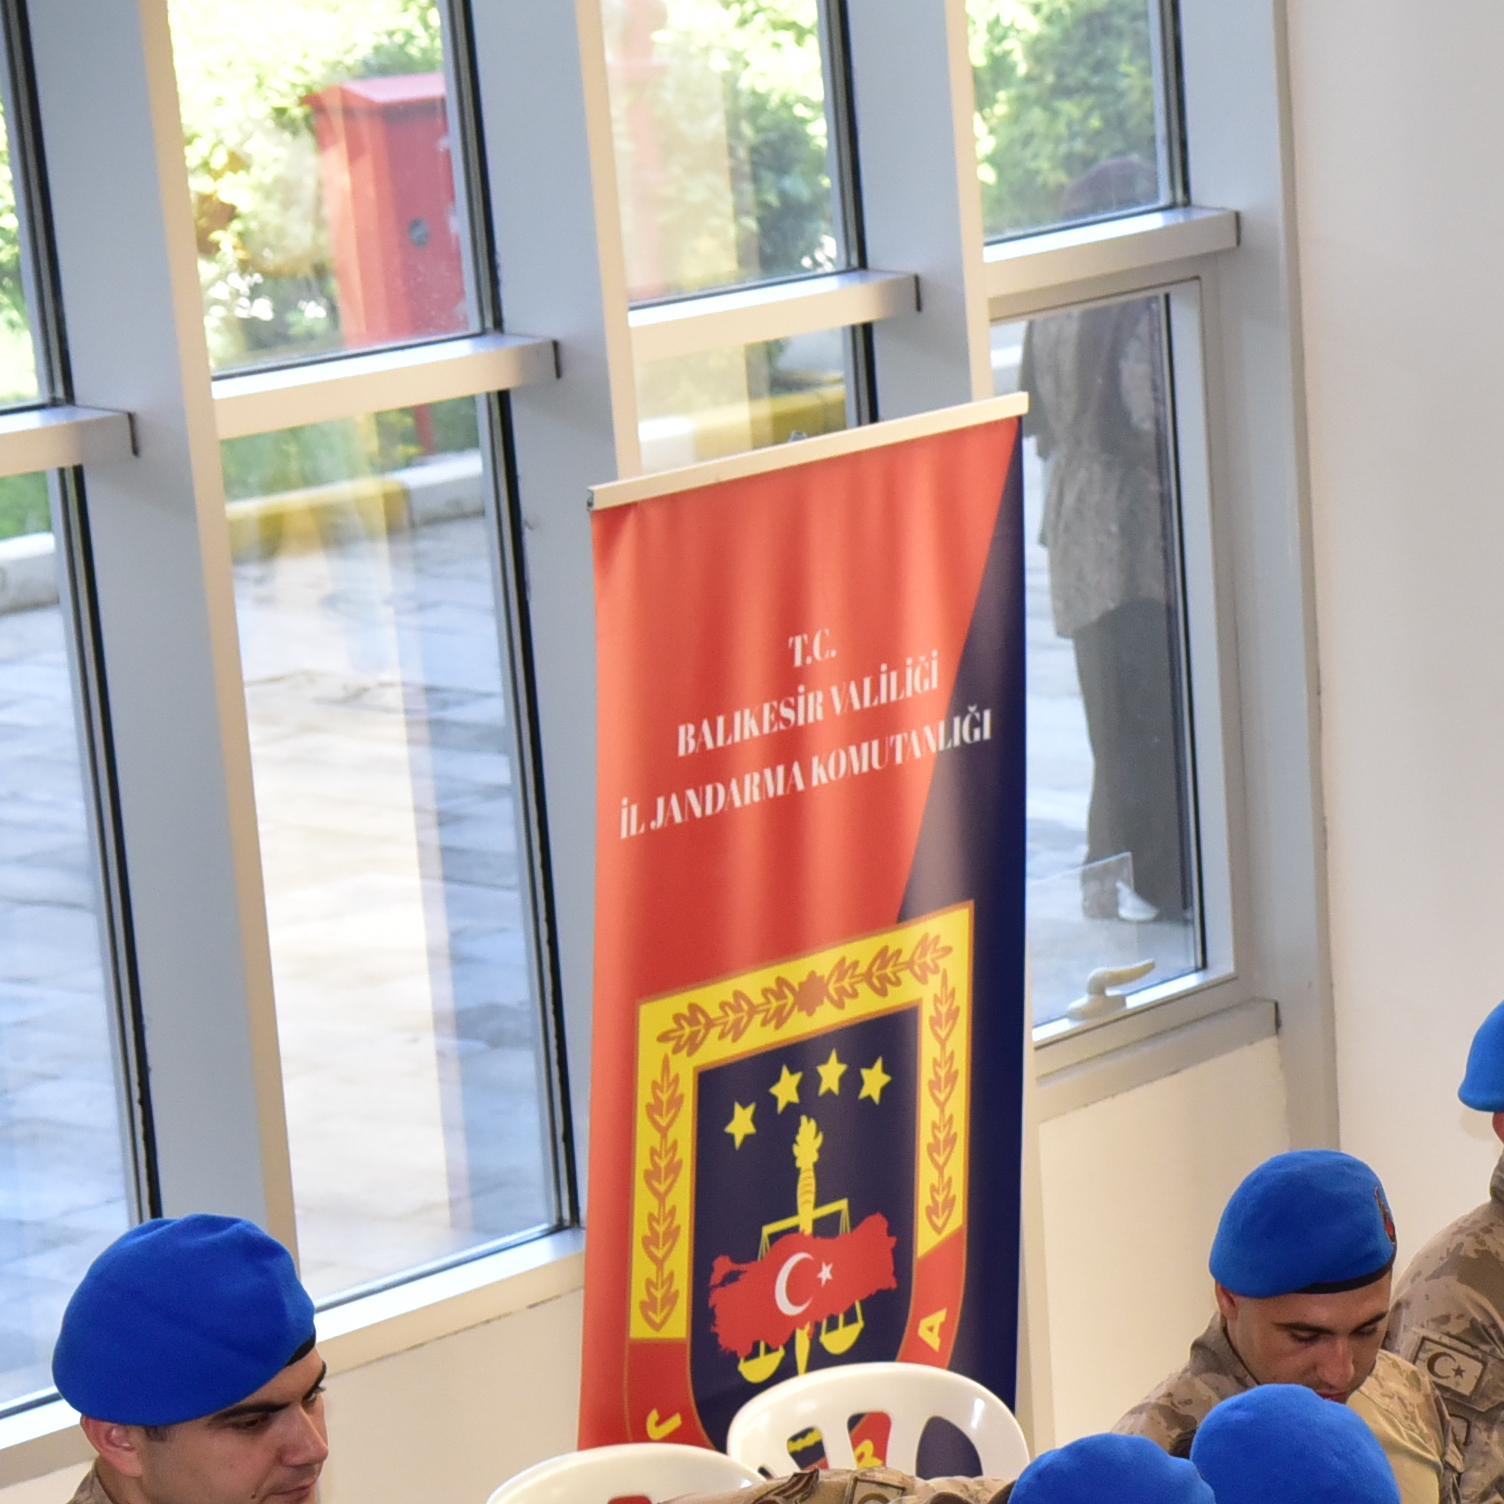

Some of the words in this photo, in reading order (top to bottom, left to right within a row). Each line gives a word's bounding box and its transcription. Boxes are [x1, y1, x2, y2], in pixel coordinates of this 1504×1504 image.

[788, 628, 838, 668] T.C.
[676, 684, 825, 758] BALIKESİR
[829, 649, 940, 717] VALİLİĞİ
[619, 796, 645, 840] İL
[650, 761, 806, 831] JANDARMA
[810, 704, 994, 786] KOMUTANLIĞI
